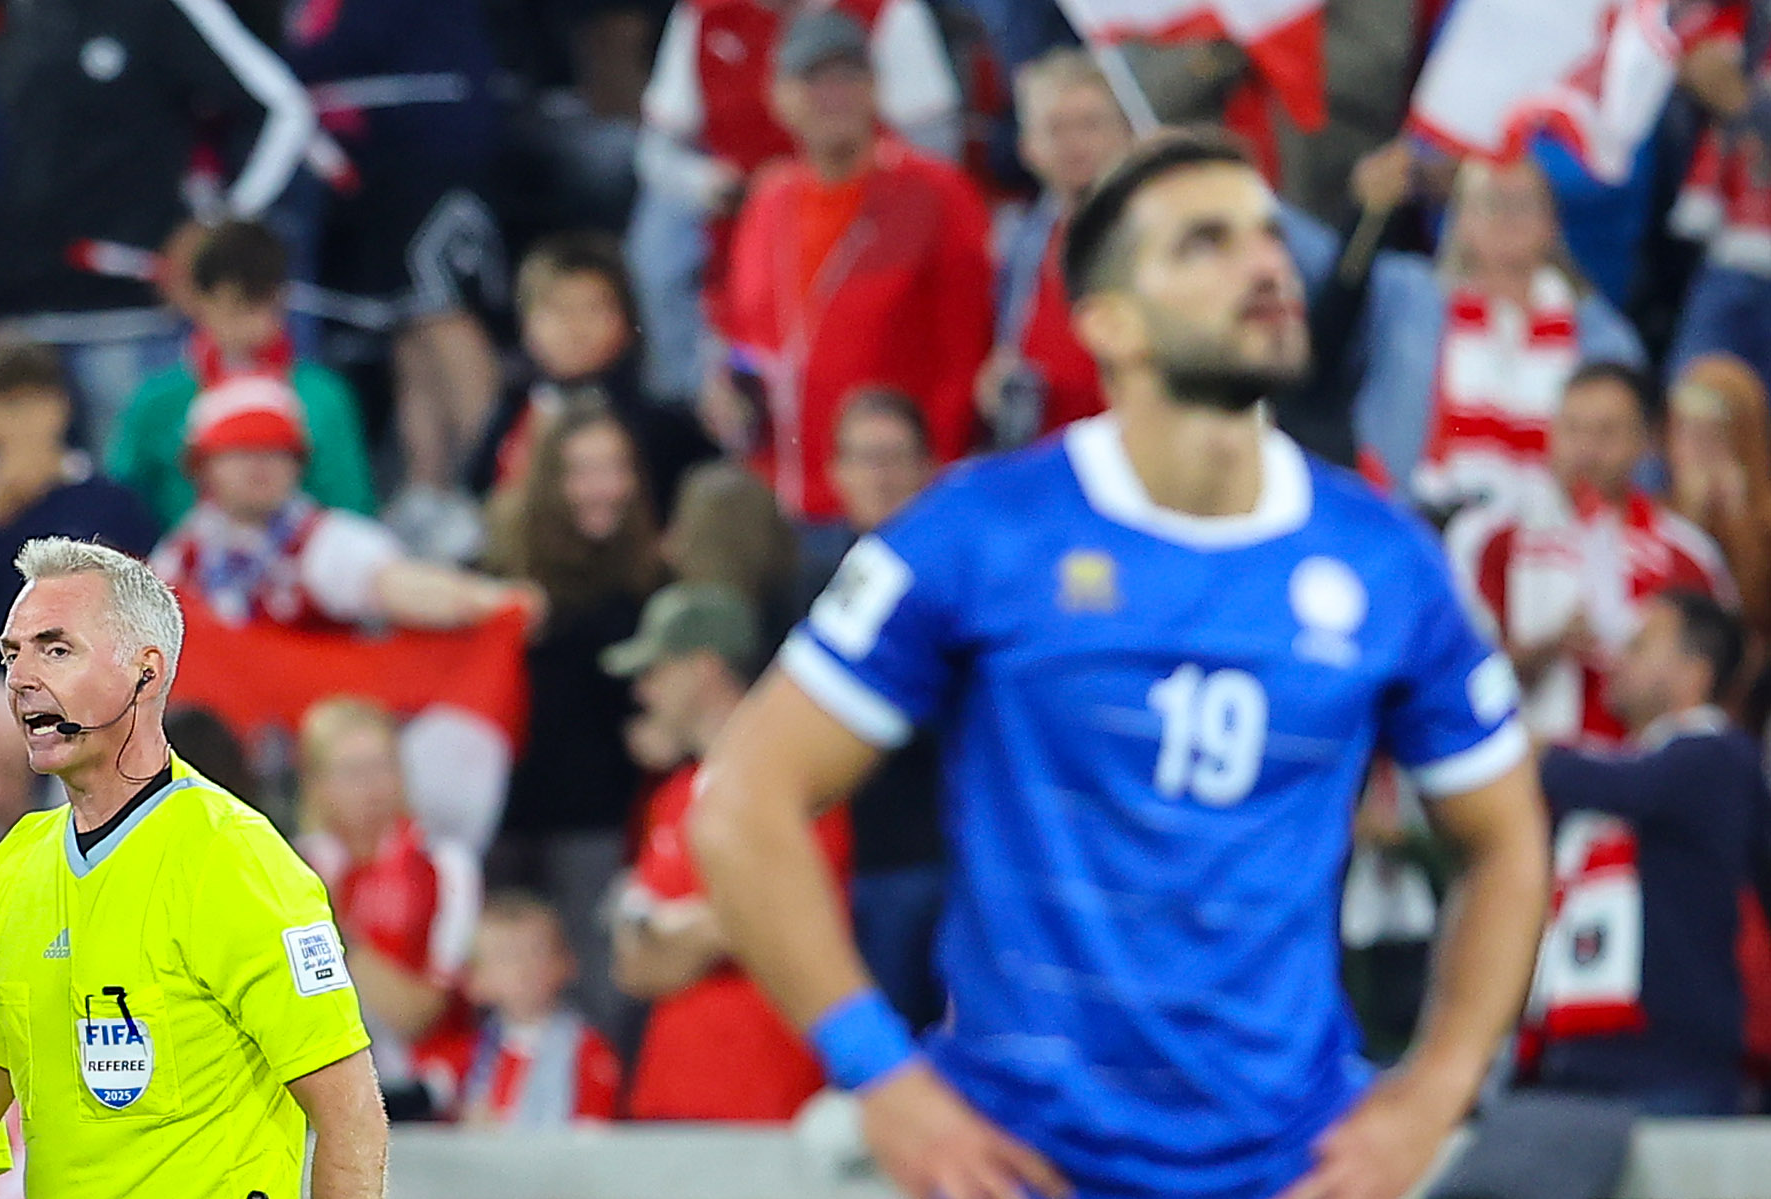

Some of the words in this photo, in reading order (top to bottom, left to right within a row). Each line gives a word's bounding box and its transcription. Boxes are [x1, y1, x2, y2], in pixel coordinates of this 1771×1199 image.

[1147, 662, 1269, 809] 19
[301, 942, 332, 959] UNITES
[85, 1024, 144, 1046] FIFA
[88, 1060, 146, 1072] REFEREE
[104, 1090, 132, 1102] 2025
